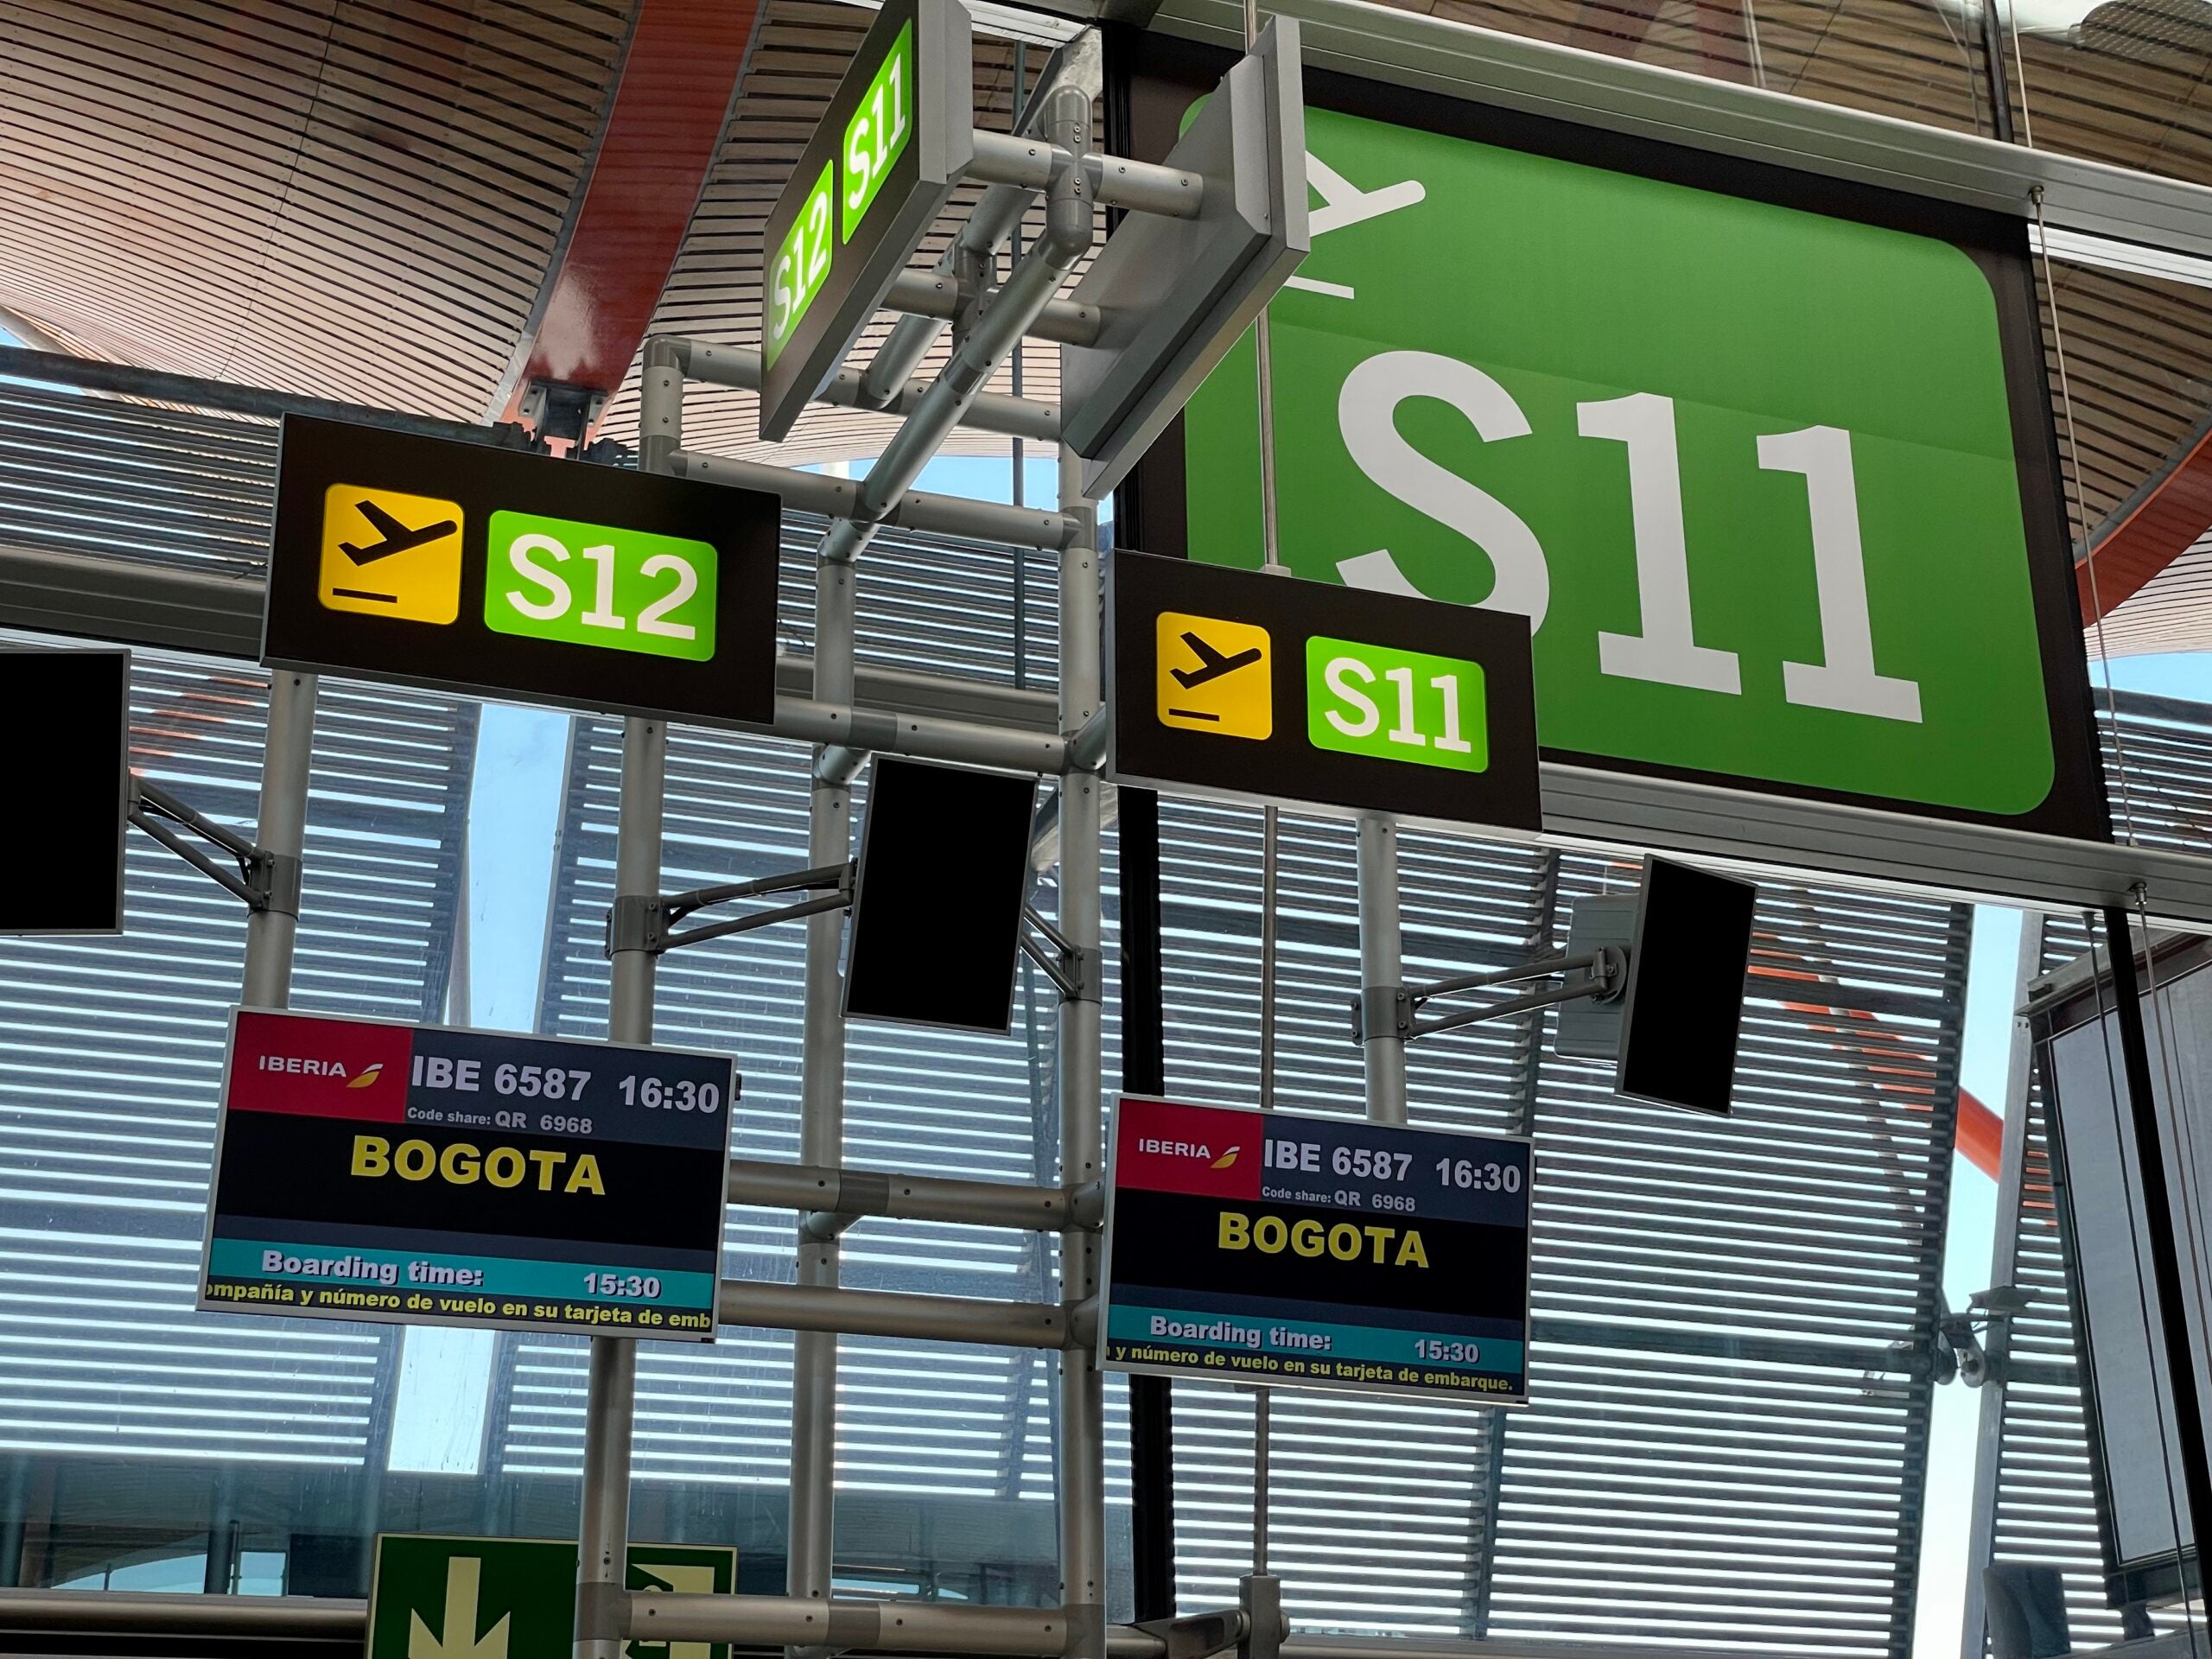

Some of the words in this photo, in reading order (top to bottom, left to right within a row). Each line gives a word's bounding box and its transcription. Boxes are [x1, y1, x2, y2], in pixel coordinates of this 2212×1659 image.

[773, 190, 828, 341] S12
[849, 52, 906, 210] S11
[1335, 350, 1924, 724] S11
[505, 533, 698, 641] S12
[1323, 657, 1472, 754] S11
[258, 1055, 347, 1078] IBERIA
[411, 1055, 481, 1092] IBE
[494, 1063, 592, 1102] 6587
[619, 1075, 720, 1114] 16:30
[407, 1106, 444, 1122] Code
[447, 1109, 491, 1126] share:
[494, 1109, 527, 1128] QR
[540, 1115, 593, 1135] 6968
[350, 1135, 606, 1196] BOGOTA
[1138, 1137, 1211, 1160] IBERIA
[1263, 1138, 1321, 1173] IBE
[1332, 1146, 1414, 1183] 6587
[1434, 1157, 1522, 1194] 16:30
[1261, 1185, 1292, 1202] Code
[1294, 1189, 1332, 1205] share:
[1333, 1190, 1362, 1208] QR
[1370, 1193, 1417, 1213] 6968
[1217, 1211, 1430, 1269] BOGOTA
[262, 1249, 399, 1284] Boarding
[408, 1260, 485, 1288] time:
[583, 1272, 662, 1299] 15:30
[300, 1288, 315, 1306] y
[319, 1288, 401, 1309] número
[407, 1294, 434, 1311] de
[440, 1298, 497, 1315] vuelo
[502, 1302, 528, 1317] en
[533, 1305, 559, 1319] su
[564, 1304, 632, 1325] tarjeta
[637, 1309, 664, 1326] de
[668, 1313, 712, 1329] emb
[1150, 1315, 1262, 1349] Boarding
[1269, 1326, 1332, 1351] time:
[1414, 1338, 1480, 1363] 15:30
[1115, 1345, 1127, 1361] y
[1130, 1344, 1199, 1364] número
[1204, 1351, 1226, 1366] de
[1230, 1353, 1279, 1370] vuelo
[1283, 1360, 1306, 1373] en
[1310, 1363, 1332, 1376] su
[1336, 1363, 1393, 1382] tarjeta
[1398, 1367, 1420, 1382] de
[1424, 1372, 1513, 1393] embarque.
